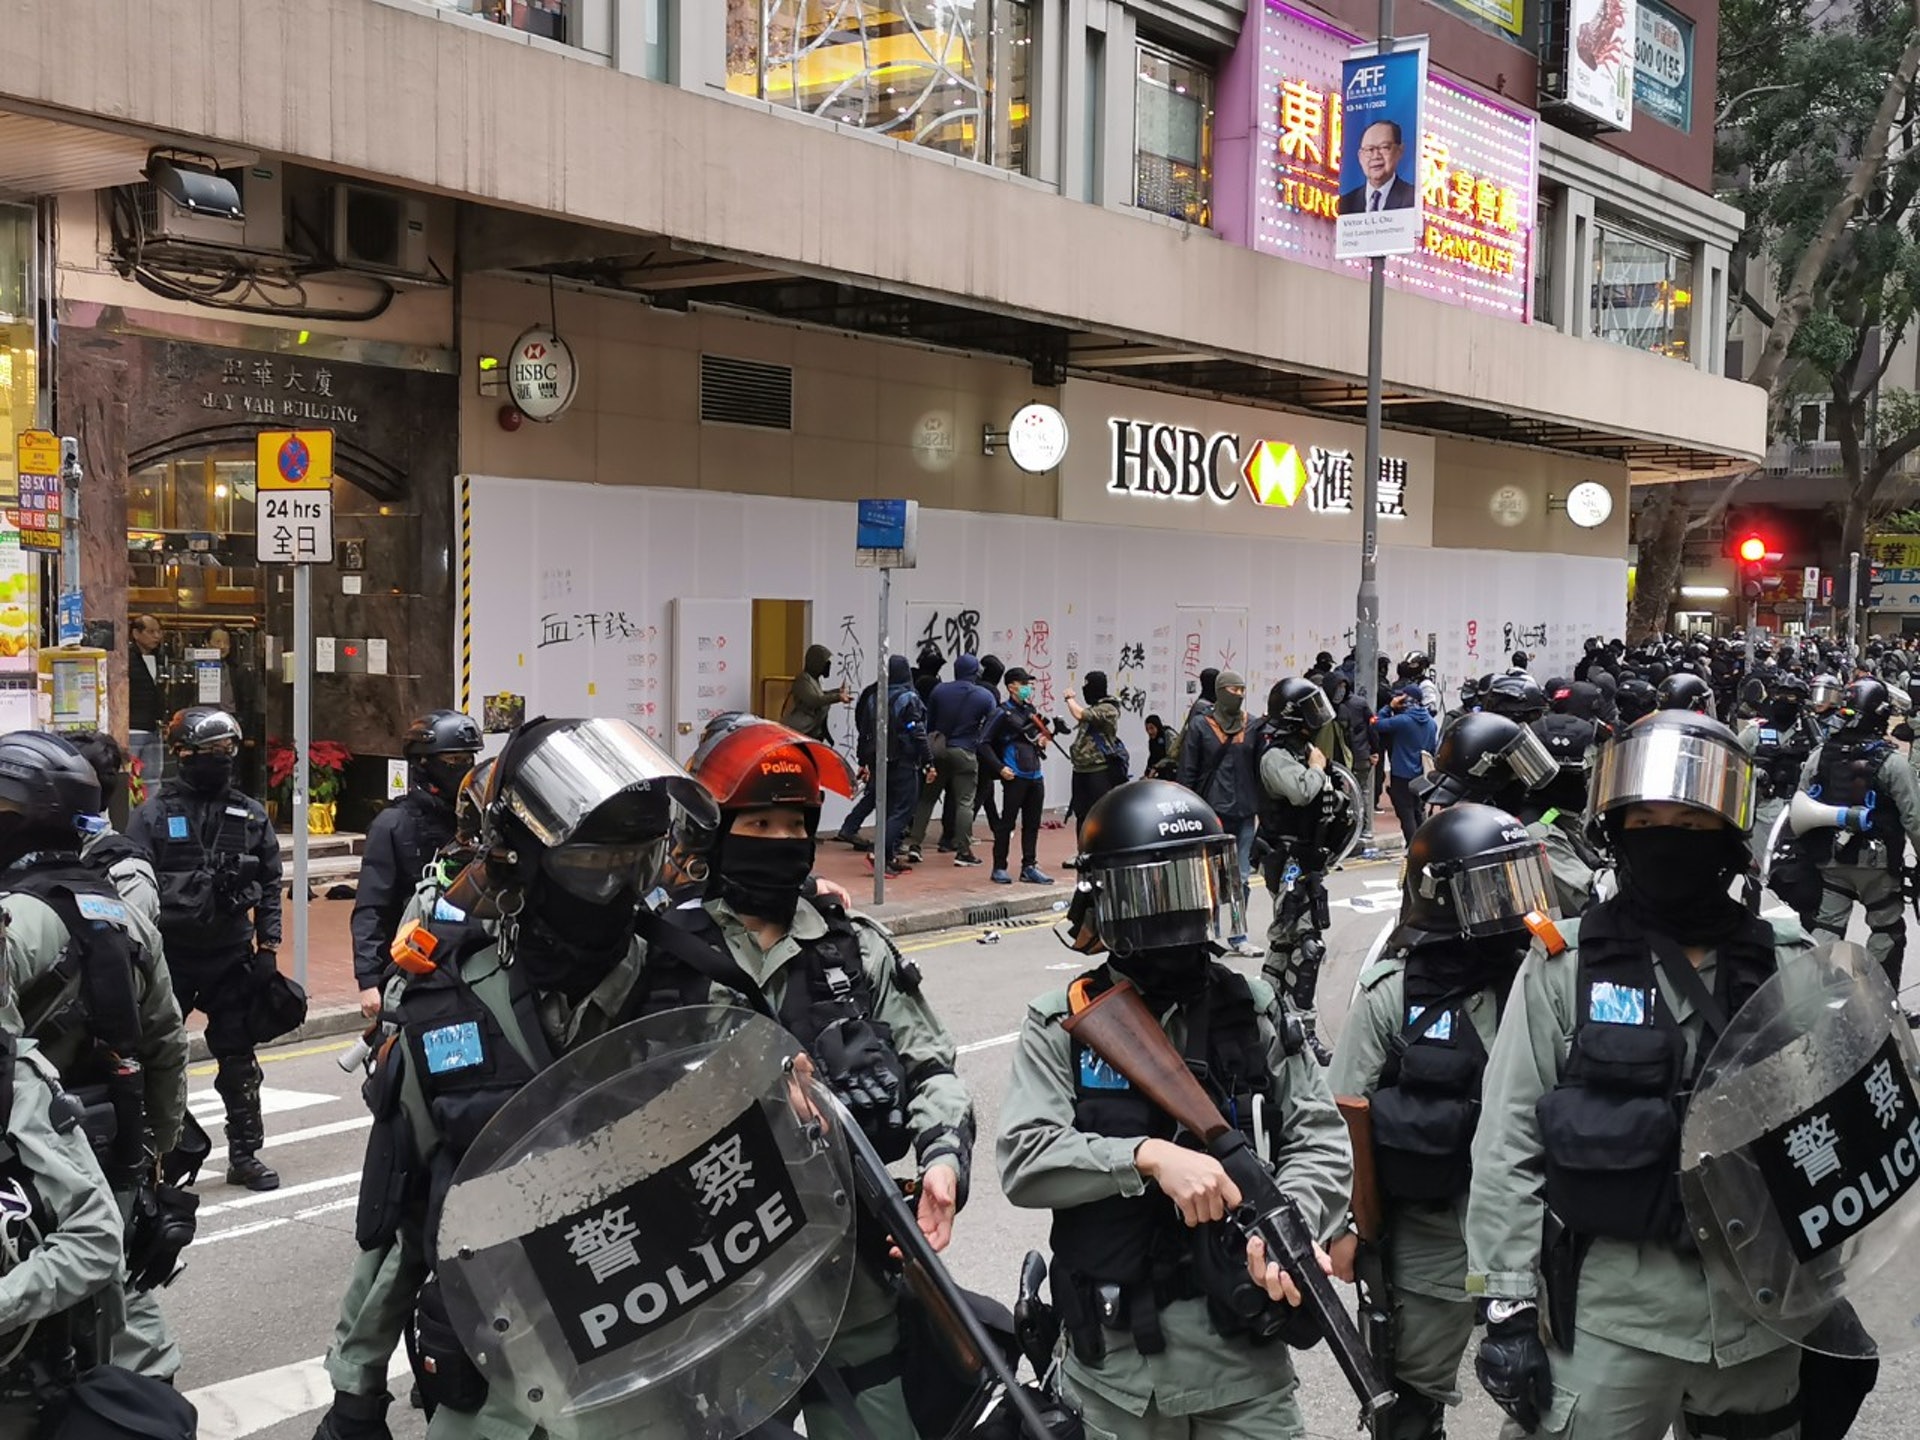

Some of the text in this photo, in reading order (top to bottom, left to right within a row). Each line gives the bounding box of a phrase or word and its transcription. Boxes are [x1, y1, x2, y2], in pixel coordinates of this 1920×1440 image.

[1347, 65, 1386, 89] AFF
[1424, 224, 1515, 276] BANQUET
[515, 363, 558, 381] HSBC
[1109, 418, 1241, 502] HSBC
[266, 499, 321, 518] 24 hrs
[273, 525, 316, 556] 全日
[761, 761, 802, 776] Police
[1158, 818, 1203, 837] Police
[1783, 1057, 1905, 1188] 警察
[564, 1133, 756, 1285] 警察
[579, 1190, 794, 1350] POLICE
